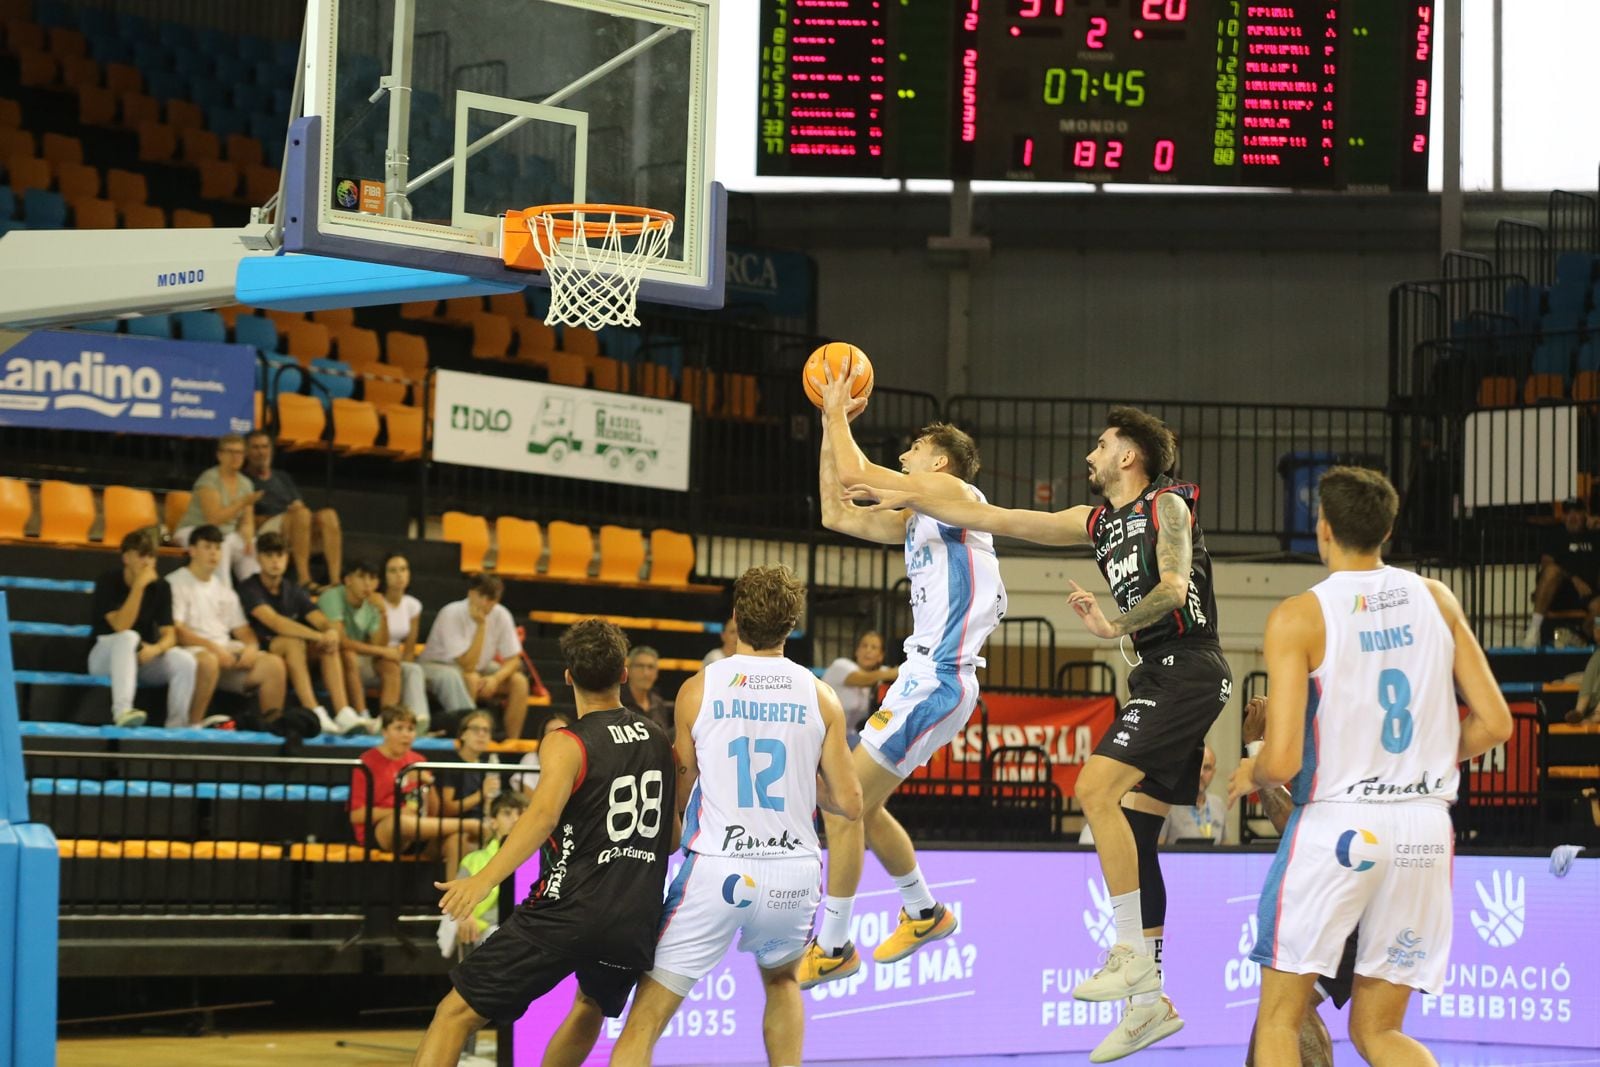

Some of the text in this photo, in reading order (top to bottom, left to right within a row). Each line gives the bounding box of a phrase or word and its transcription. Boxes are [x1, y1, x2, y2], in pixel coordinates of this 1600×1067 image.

[1086, 17, 1108, 48] 2
[1044, 68, 1146, 107] 07:45
[1060, 119, 1129, 133] MONDO
[157, 269, 205, 288] MONDO
[725, 250, 779, 289] RCA
[1105, 518, 1124, 549] 23
[749, 674, 793, 684] ESPORTS
[713, 699, 807, 725] D.ALDERETE
[1377, 668, 1414, 754] 8
[607, 721, 650, 744] DIAS
[728, 736, 787, 812] 12
[606, 770, 663, 843] 88
[1393, 855, 1437, 869] center
[1395, 843, 1446, 854] carreras
[766, 900, 802, 910] center
[769, 888, 810, 899] carreras
[917, 939, 978, 986] MÀ?
[1442, 962, 1571, 992] UNDACIÓ
[1042, 1001, 1123, 1027] FEBIB1
[1421, 993, 1572, 1023] FEBIB1935
